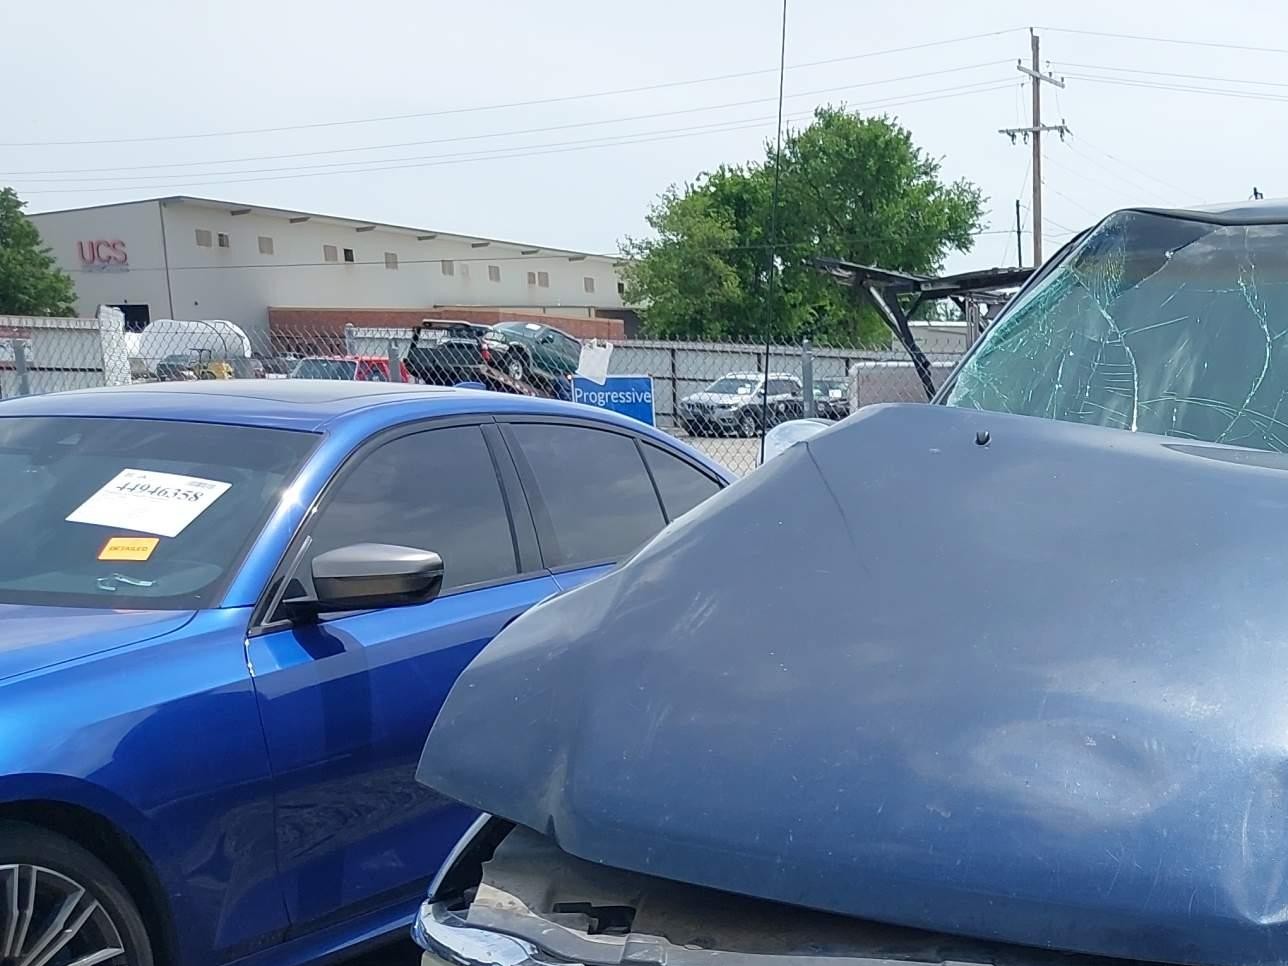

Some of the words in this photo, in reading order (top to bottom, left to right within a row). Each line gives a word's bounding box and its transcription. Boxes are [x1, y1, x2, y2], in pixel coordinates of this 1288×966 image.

[77, 240, 128, 265] UCS
[574, 388, 652, 406] Progressive
[116, 481, 204, 502] 44946358
